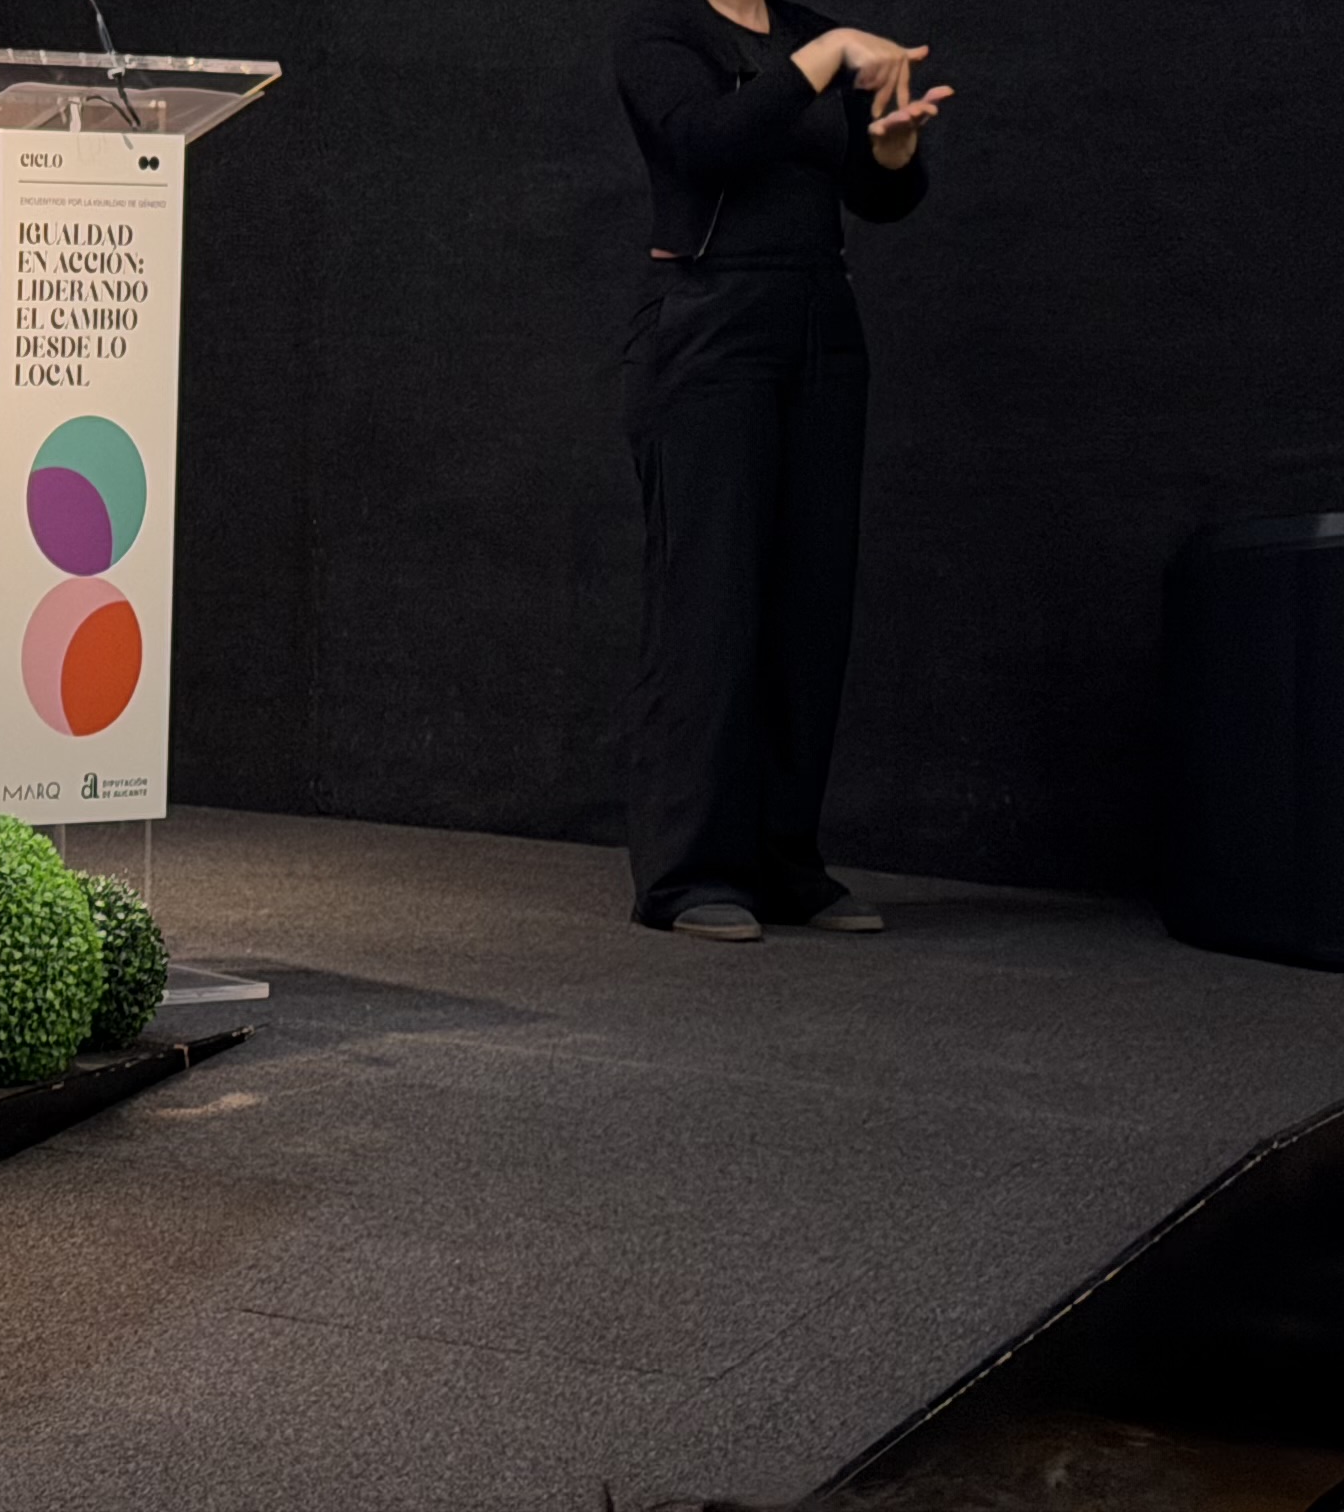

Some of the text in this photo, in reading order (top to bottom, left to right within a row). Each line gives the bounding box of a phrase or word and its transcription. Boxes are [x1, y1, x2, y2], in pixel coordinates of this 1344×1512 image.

[19, 152, 63, 168] CICLO
[18, 221, 134, 247] IGUALDAD
[17, 246, 145, 275] EN ACCIÓN:
[17, 278, 149, 303] LIDERANDO
[16, 306, 138, 331] EL CAMBIO
[15, 335, 127, 359] DESDE LO
[14, 363, 90, 387] LOCAL
[2, 781, 61, 802] MARQ
